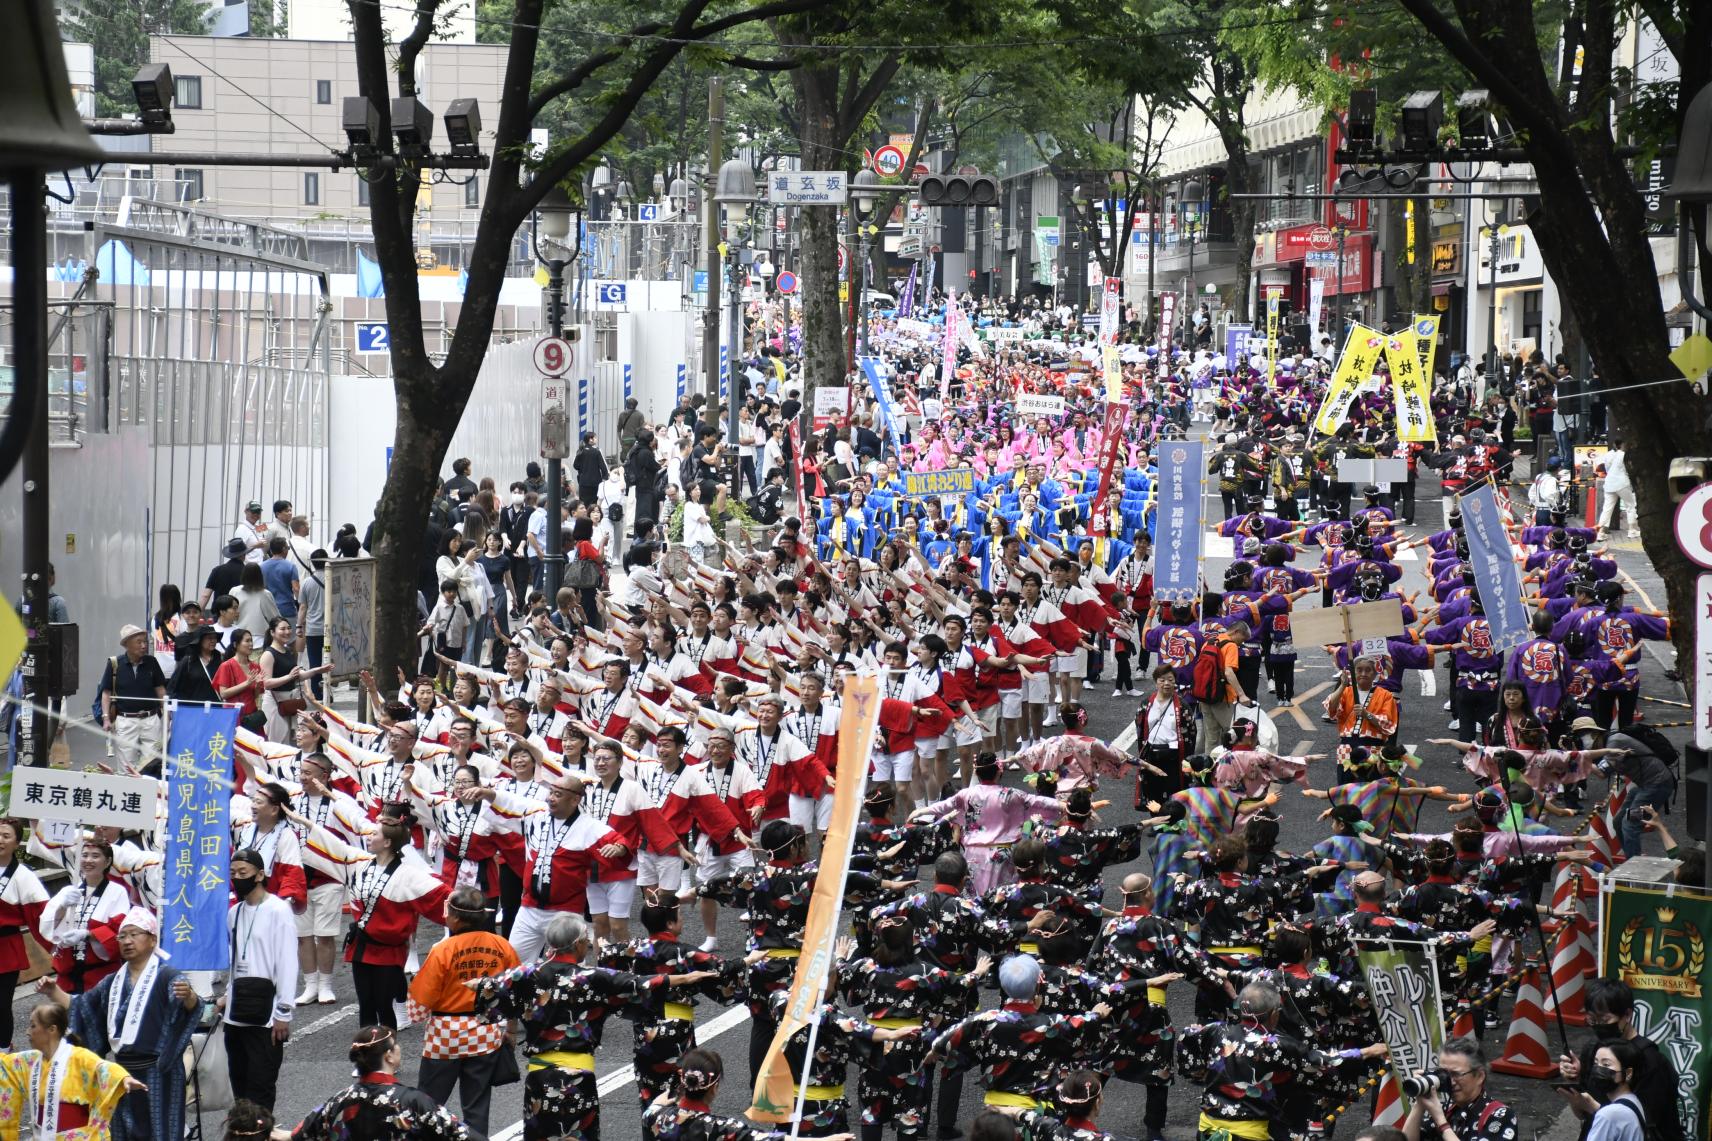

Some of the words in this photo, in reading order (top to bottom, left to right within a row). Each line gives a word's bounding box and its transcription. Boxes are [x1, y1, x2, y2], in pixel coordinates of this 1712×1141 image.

[775, 176, 841, 191] 道玄坂
[786, 192, 829, 202] Dogenzaka
[644, 206, 654, 220] 4
[607, 285, 622, 301] G
[370, 325, 388, 348] 2
[543, 343, 564, 371] 9
[1365, 640, 1385, 651] 32
[24, 782, 142, 814] 東京鶴丸連
[197, 731, 230, 892] 東京世田谷
[50, 821, 70, 836] 17
[170, 748, 198, 945] 鹿児島県人会
[1639, 926, 1685, 971] 15
